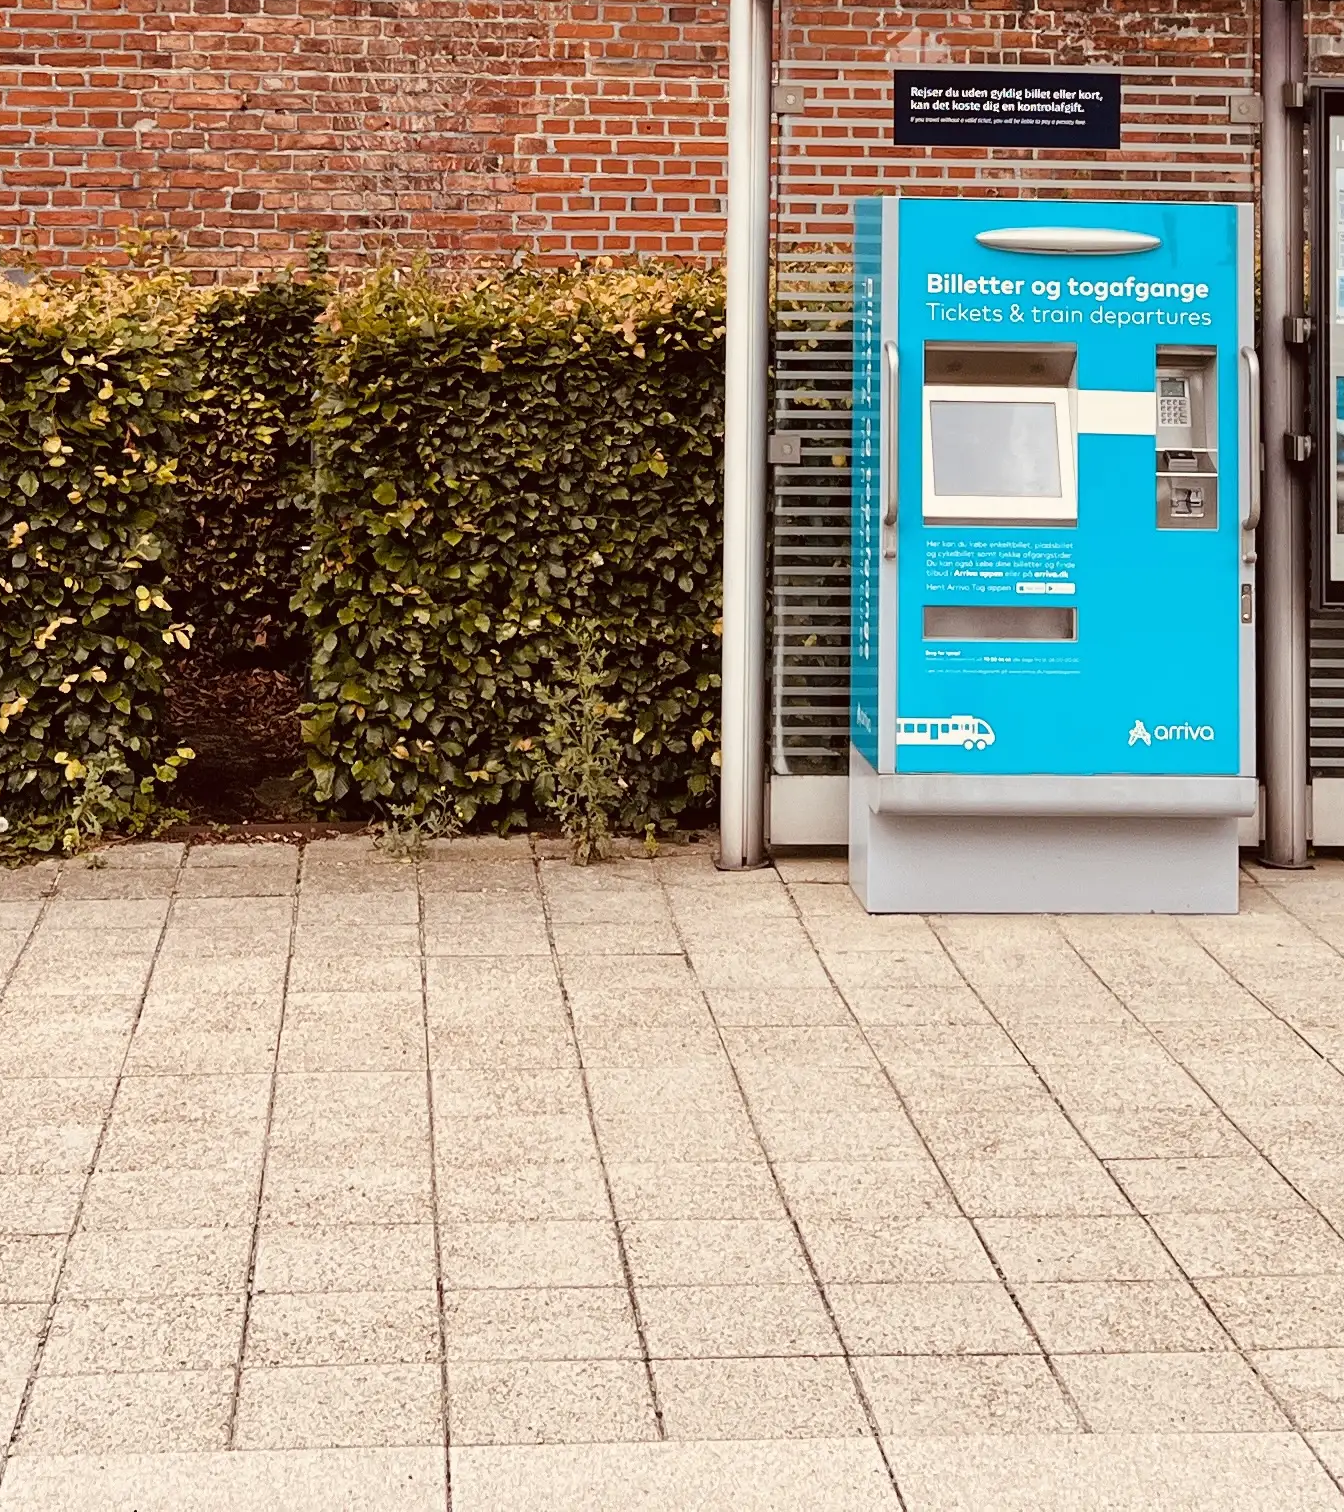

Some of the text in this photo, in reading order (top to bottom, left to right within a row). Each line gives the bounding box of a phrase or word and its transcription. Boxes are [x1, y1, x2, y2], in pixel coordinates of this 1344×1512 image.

[910, 86, 1104, 101] Rejser du uden gyldig billet eller kort,
[910, 99, 1086, 114] kan det koste dig en kontrolafgift.
[927, 273, 1209, 303] Billetter og togafgange
[926, 302, 1212, 328] Tickets & train departures
[1153, 721, 1215, 741] arriva
